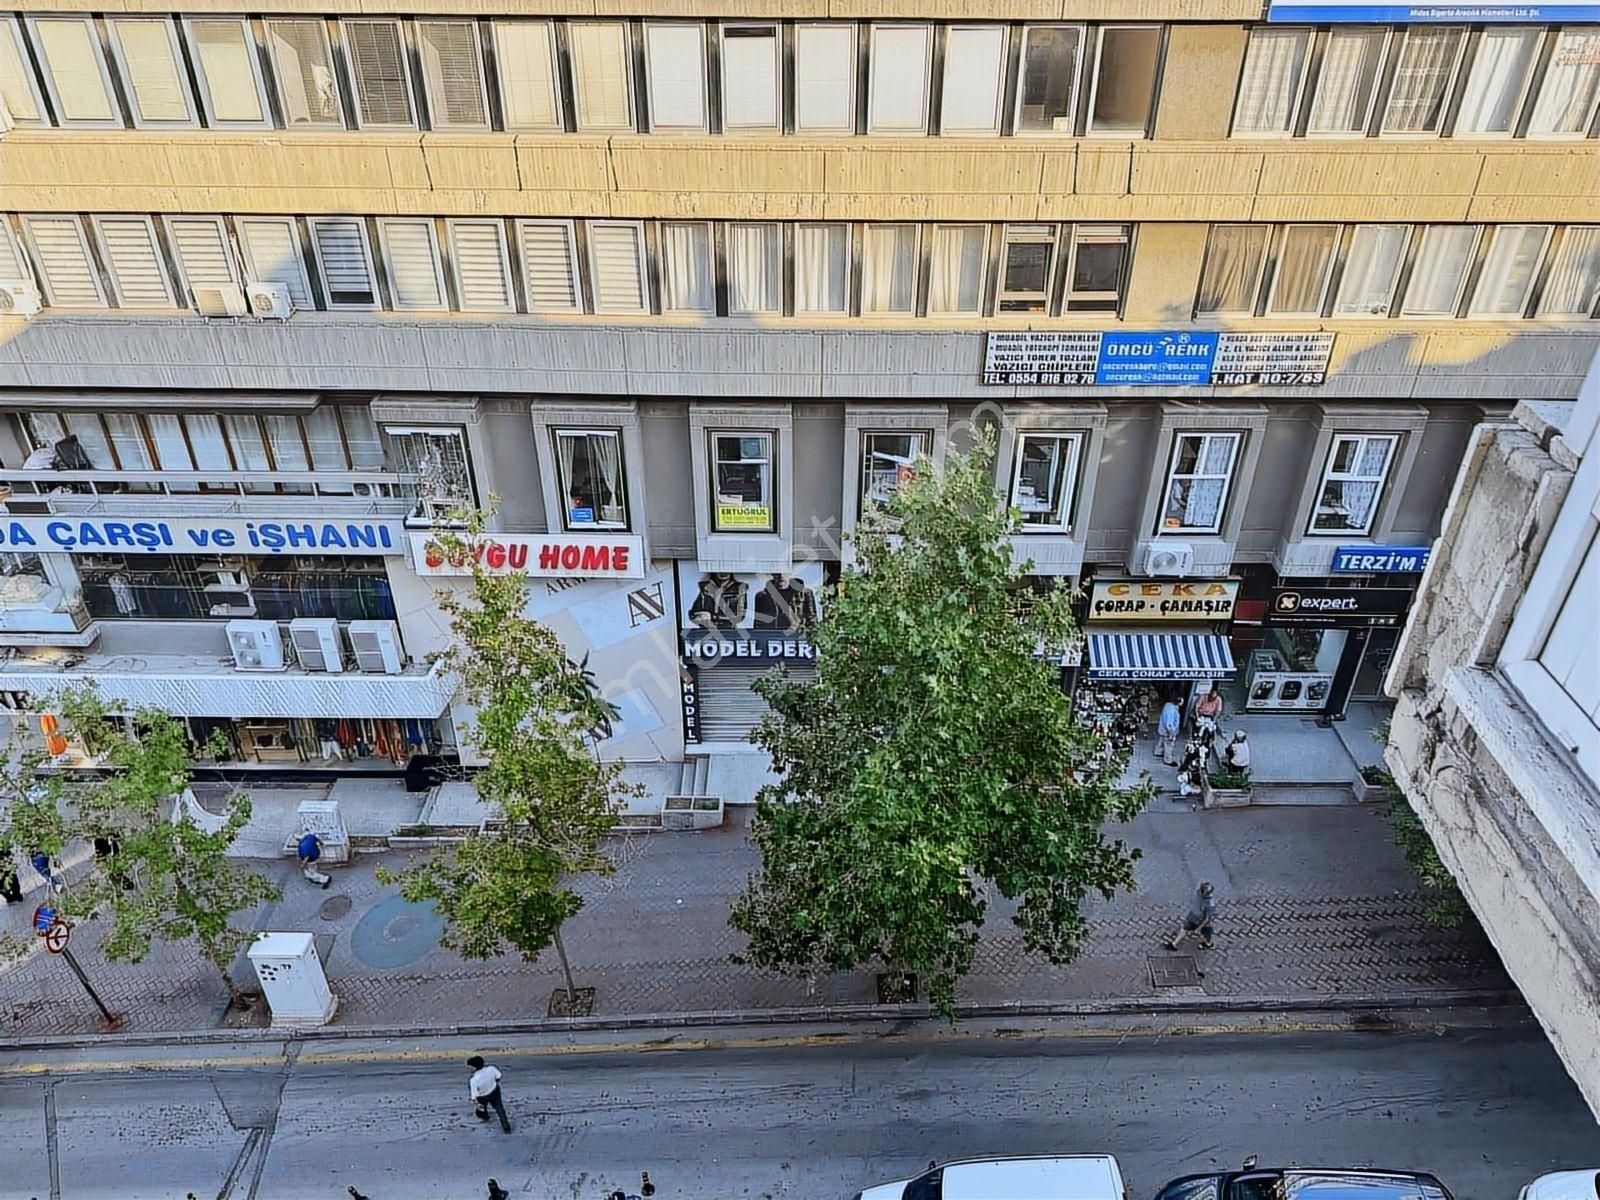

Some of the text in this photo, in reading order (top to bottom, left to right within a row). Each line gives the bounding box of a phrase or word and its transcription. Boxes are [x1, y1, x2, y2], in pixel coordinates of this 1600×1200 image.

[1107, 341, 1209, 356] ÖNCÜ RENK
[993, 363, 1033, 371] YAZICI
[983, 373, 1005, 384] TEL:
[1008, 373, 1037, 384] 0554
[1064, 373, 1078, 384] 02
[0, 522, 36, 546] A
[46, 521, 173, 551] ÇARŞI
[187, 529, 236, 547] ve
[539, 544, 630, 571] HOME
[1340, 552, 1417, 571] TERZİ'M
[1107, 583, 1228, 597] CEKA
[1094, 600, 1146, 616] ÇORAP
[1159, 600, 1232, 616] ÇAMAŞIR
[684, 639, 763, 658] MODEL
[1132, 670, 1171, 678] ÇORAP
[683, 683, 696, 738] MODEL
